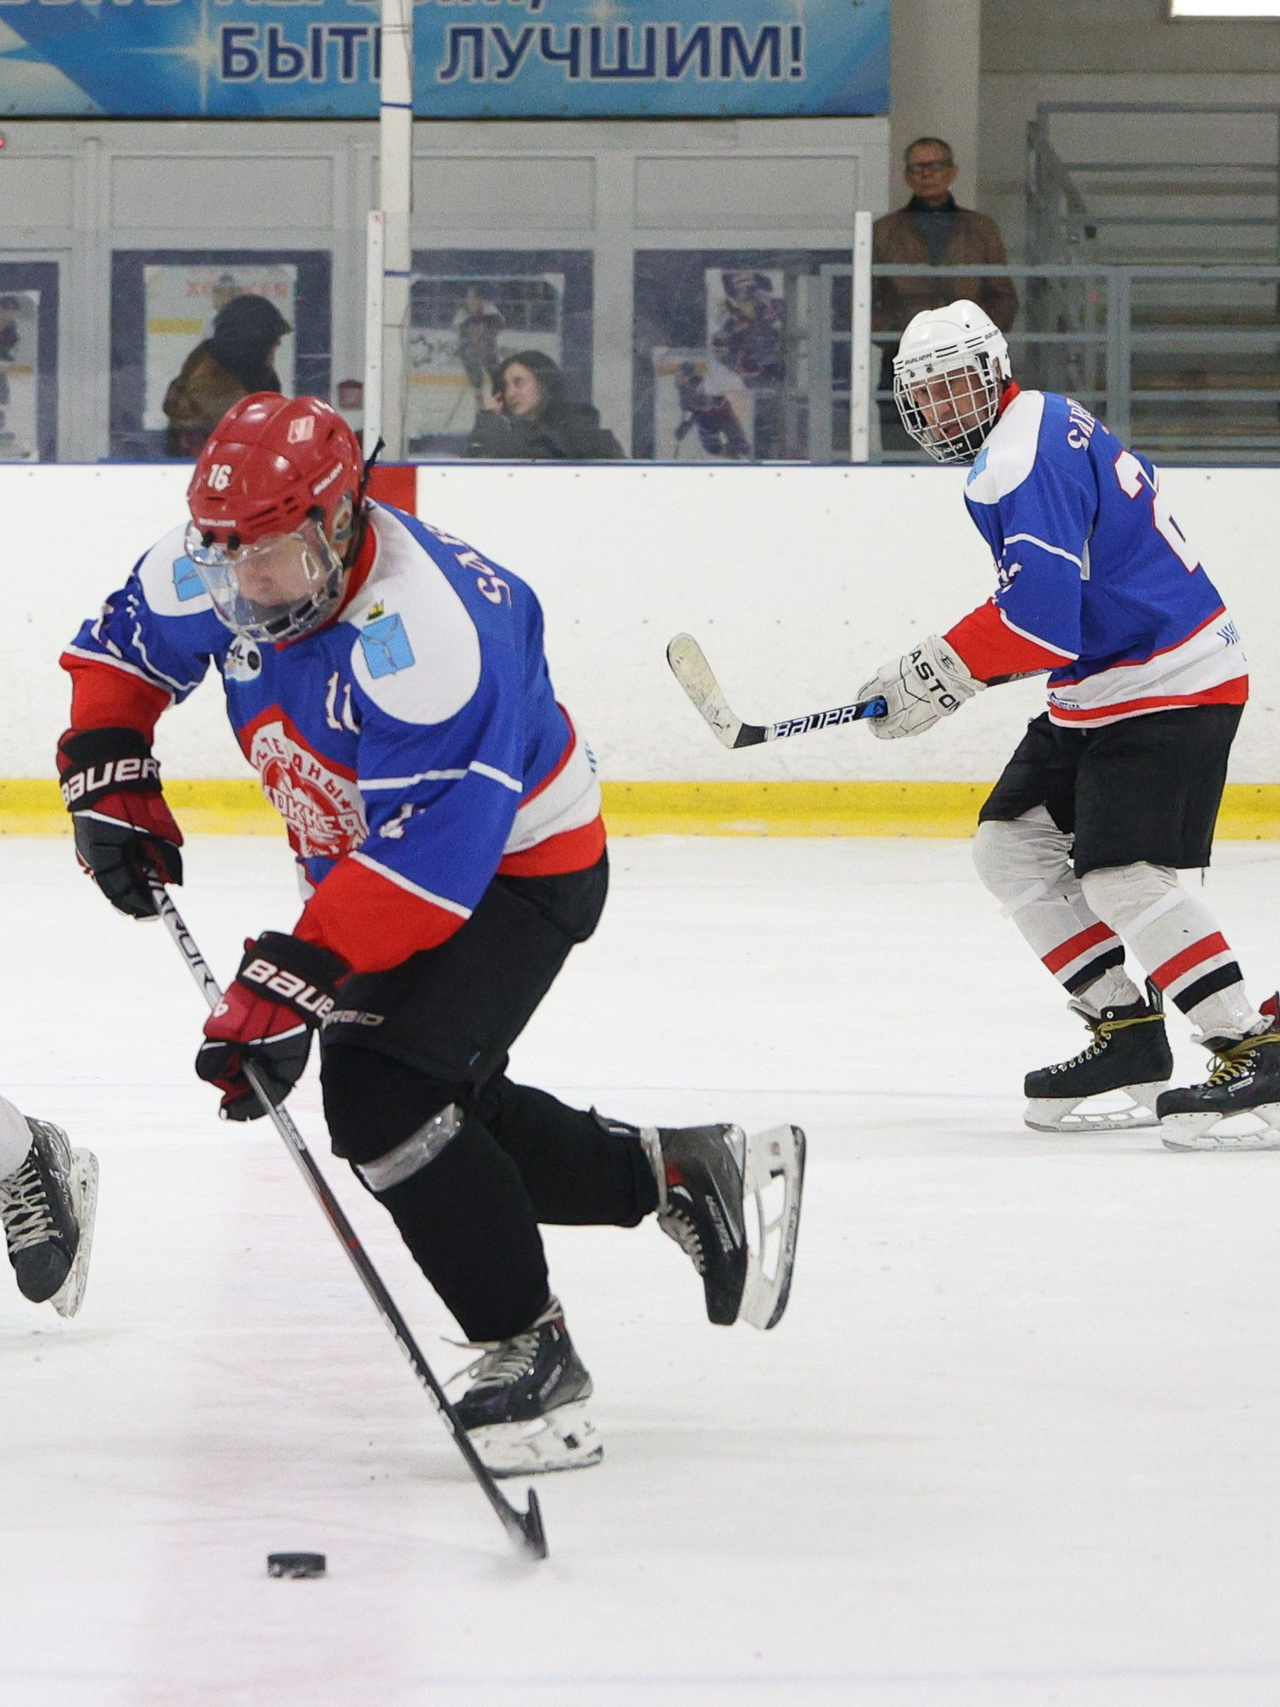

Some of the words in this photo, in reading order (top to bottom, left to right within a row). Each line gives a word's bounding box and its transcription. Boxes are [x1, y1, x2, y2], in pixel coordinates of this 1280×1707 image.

[438, 24, 804, 80] ЛУЧШИМ!
[206, 463, 233, 492] 16
[909, 642, 961, 712] ASTON
[773, 704, 857, 740] BAUER
[61, 758, 159, 807] BAUER
[242, 958, 335, 1020] BAUE
